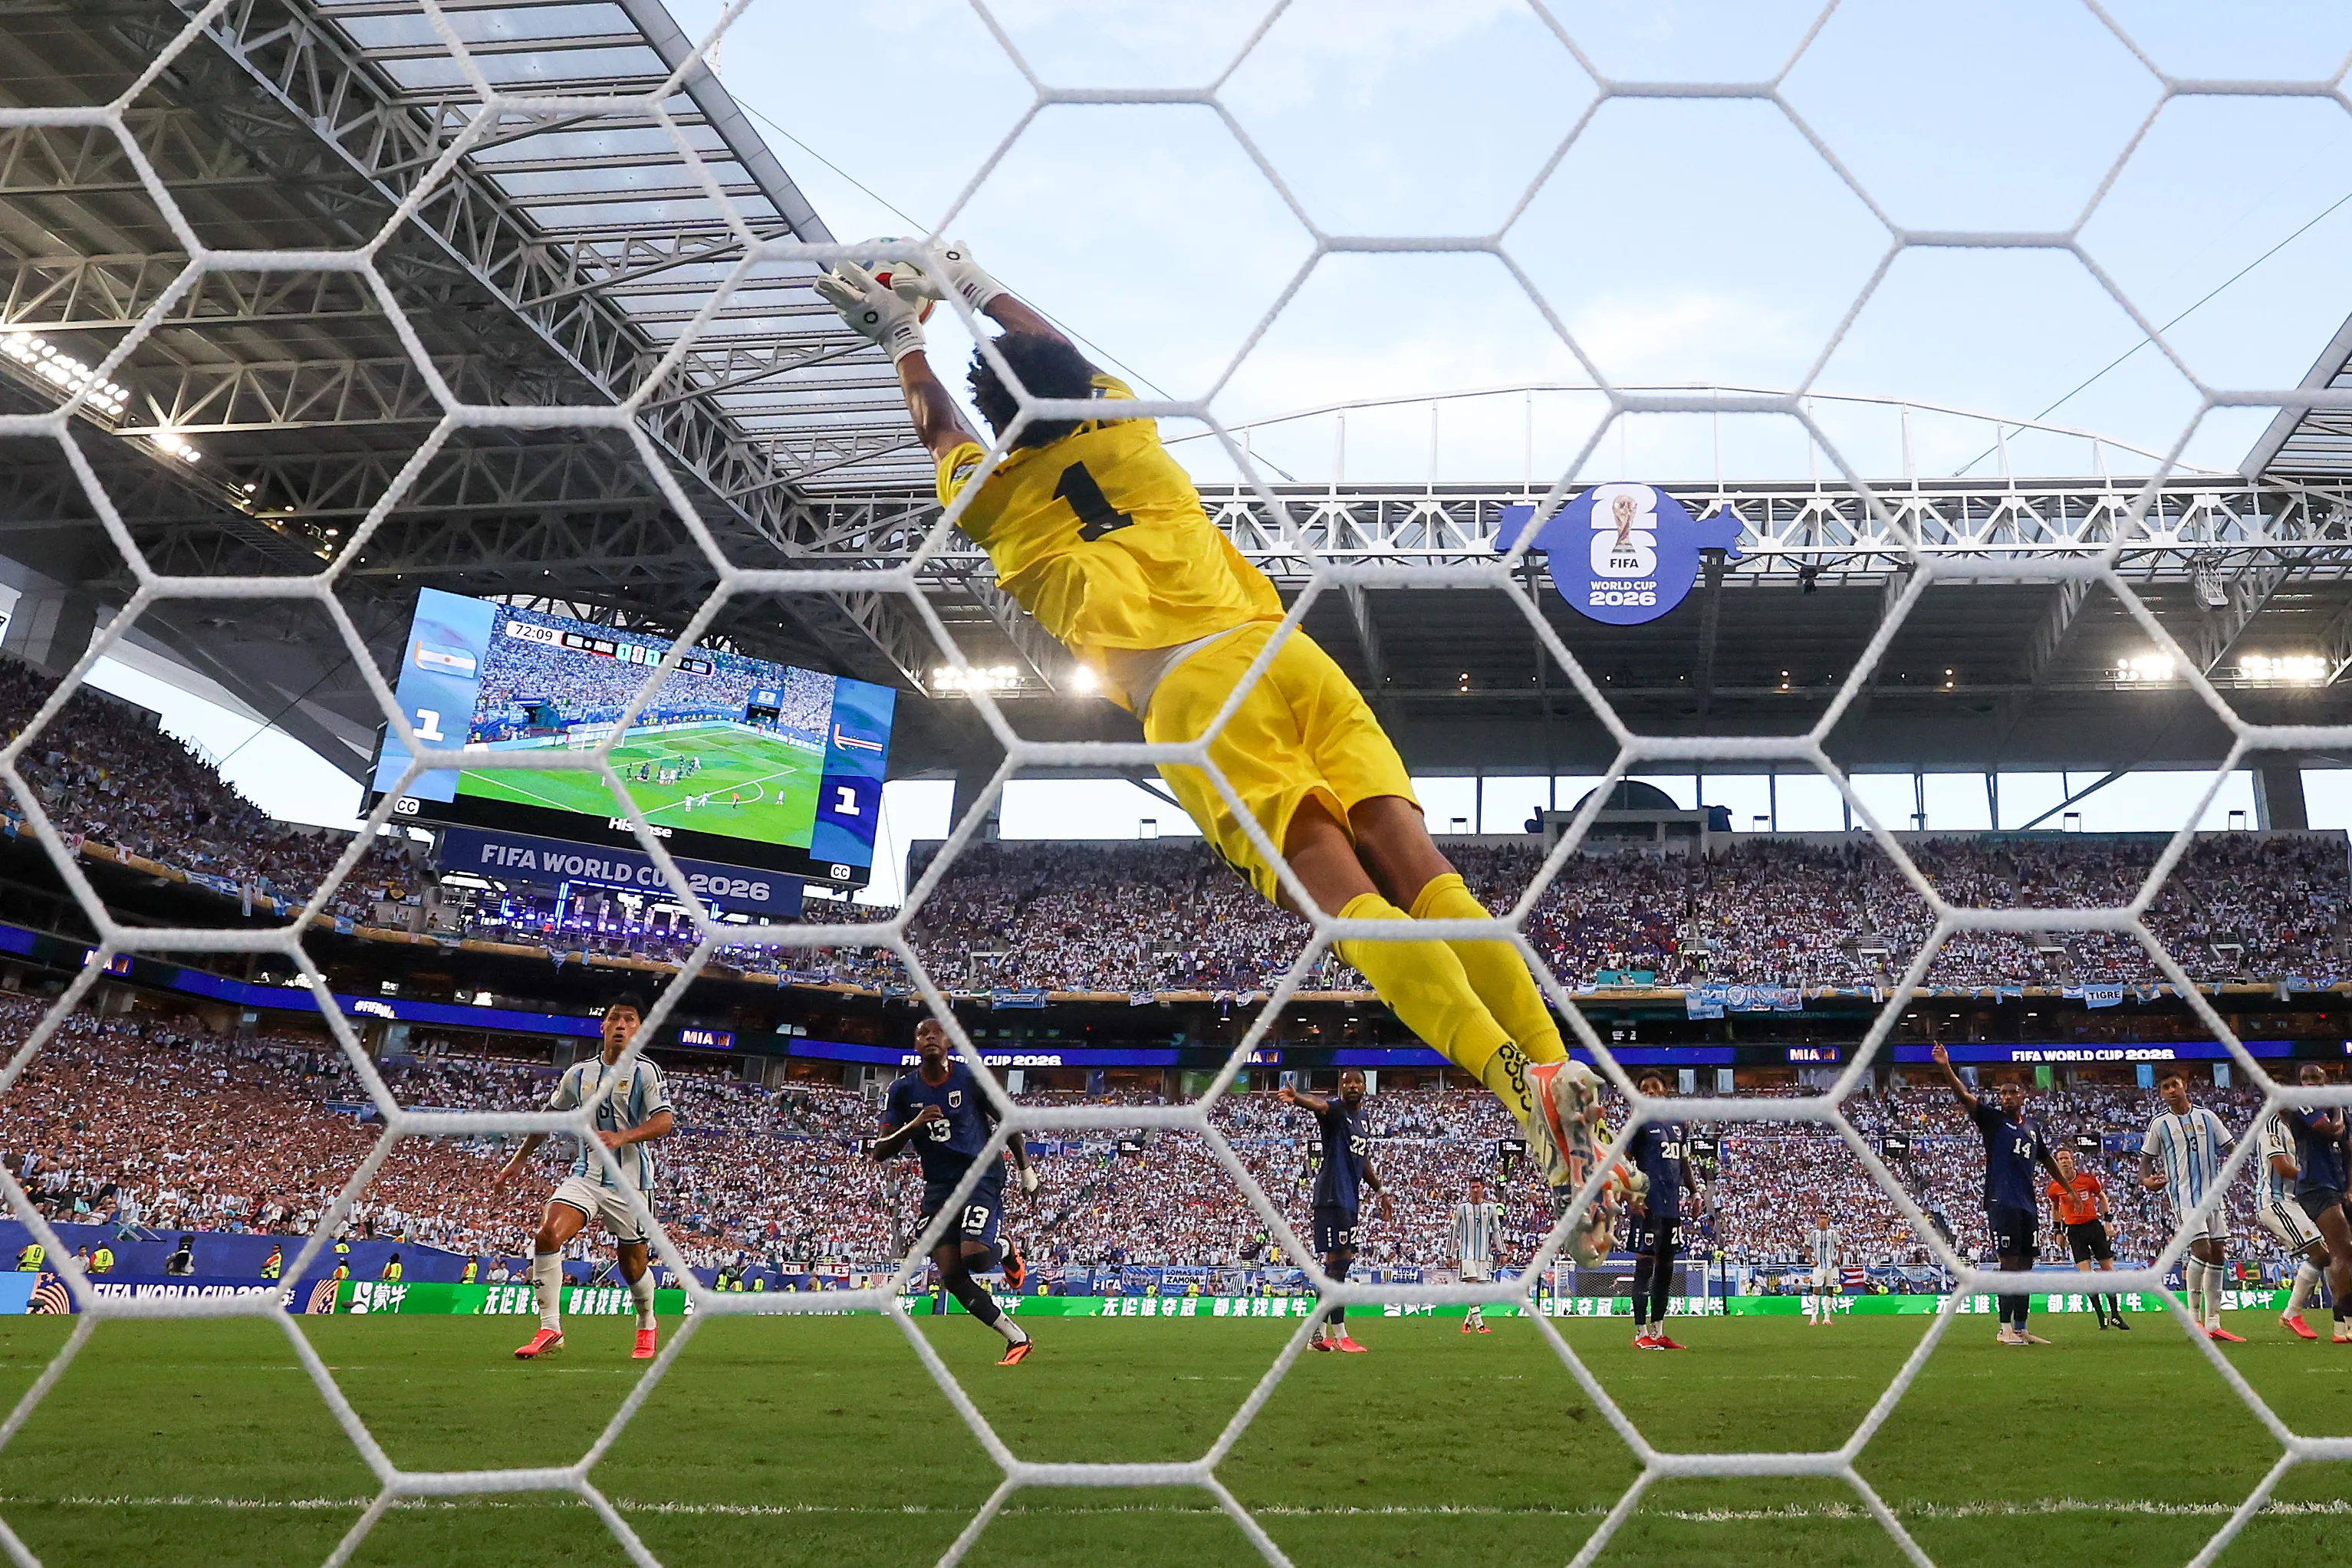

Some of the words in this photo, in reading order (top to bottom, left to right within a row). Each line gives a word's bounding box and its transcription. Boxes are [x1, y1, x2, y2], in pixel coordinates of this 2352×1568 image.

[1052, 462, 1133, 541] 1
[1610, 558, 1639, 568] FIFA
[1590, 580, 1633, 590] WORLD
[1633, 580, 1657, 590] CUP
[1589, 591, 1656, 606] 2026
[515, 624, 553, 641] 72:09
[593, 638, 613, 654] ARG
[413, 708, 445, 742] 1
[397, 800, 416, 813] CC
[834, 786, 860, 816] 1
[608, 817, 673, 838] Hisse
[480, 843, 537, 870] FIFA
[542, 852, 633, 883] WORLD
[688, 873, 770, 902] 2026
[833, 866, 848, 878] CC
[84, 950, 112, 970] MA
[2088, 991, 2120, 1000] TIGRE
[682, 1031, 714, 1046] MIA
[901, 1055, 922, 1066] FIF
[984, 1055, 1012, 1067] CUP
[1012, 1055, 1062, 1067] 2026
[1789, 1048, 1821, 1061] MIA
[2012, 1050, 2043, 1062] FIFA
[2043, 1050, 2094, 1061] WORLD
[2095, 1050, 2125, 1061] CUP
[2125, 1048, 2176, 1060] 2026
[1349, 1134, 1367, 1157] 22
[1660, 1141, 1680, 1160] 20
[2012, 1137, 2032, 1159] 14
[962, 1205, 990, 1229] 13
[661, 1271, 676, 1287] FIF
[1166, 1268, 1194, 1277] LOMAS
[1166, 1276, 1200, 1284] ZAMORA
[2163, 1273, 2180, 1285] FA
[372, 1284, 406, 1313] 蒙牛
[483, 1287, 540, 1315] 无论谁
[1936, 1294, 2031, 1313] 无论谁
[1100, 1297, 1197, 1317] 无论谁夺冠
[1212, 1297, 1308, 1317] 都来找蒙牛
